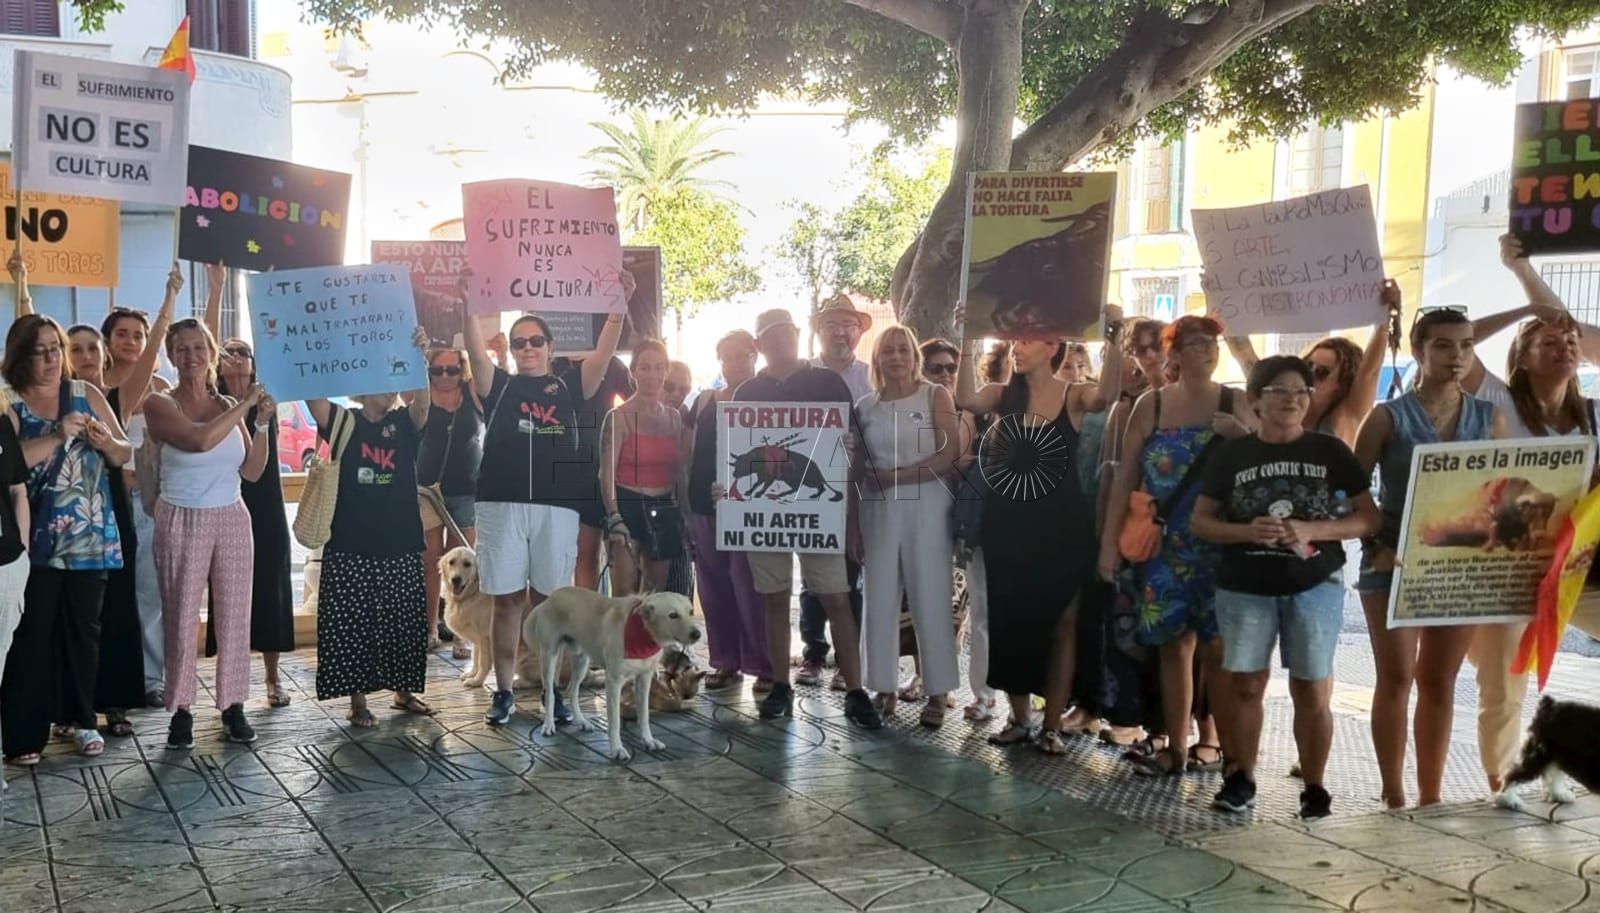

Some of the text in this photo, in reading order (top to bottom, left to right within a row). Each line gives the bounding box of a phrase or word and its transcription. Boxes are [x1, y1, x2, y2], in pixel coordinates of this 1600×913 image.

[42, 73, 175, 102] EL SUFRIMIENTO
[46, 113, 149, 148] NO ES
[56, 156, 149, 181] CULTURA
[974, 176, 1084, 189] PARA DIVERTIRSE
[527, 186, 555, 209] EL
[973, 190, 1073, 203] NO HACE FALTA
[185, 185, 342, 231] ABOLICION
[972, 204, 1050, 217] LA TORTURA
[5, 205, 69, 243] NO
[485, 217, 616, 242] SUFRIMIENTO
[382, 242, 426, 257] ESTO
[518, 241, 573, 257] NUNCA
[42, 249, 105, 276] TOROS
[430, 256, 465, 273] AR
[534, 258, 554, 272] ES
[509, 278, 593, 298] CULTURA
[305, 294, 369, 314] QUE TE
[282, 329, 394, 354] A LOS TOROS
[295, 358, 369, 377] TAMPOCO
[723, 407, 844, 429] TORTURA
[1421, 447, 1585, 473] Esta es la imagen
[1302, 463, 1328, 479] TRIP
[743, 513, 820, 529] NI ARTE
[724, 531, 839, 549] NI CULTURA
